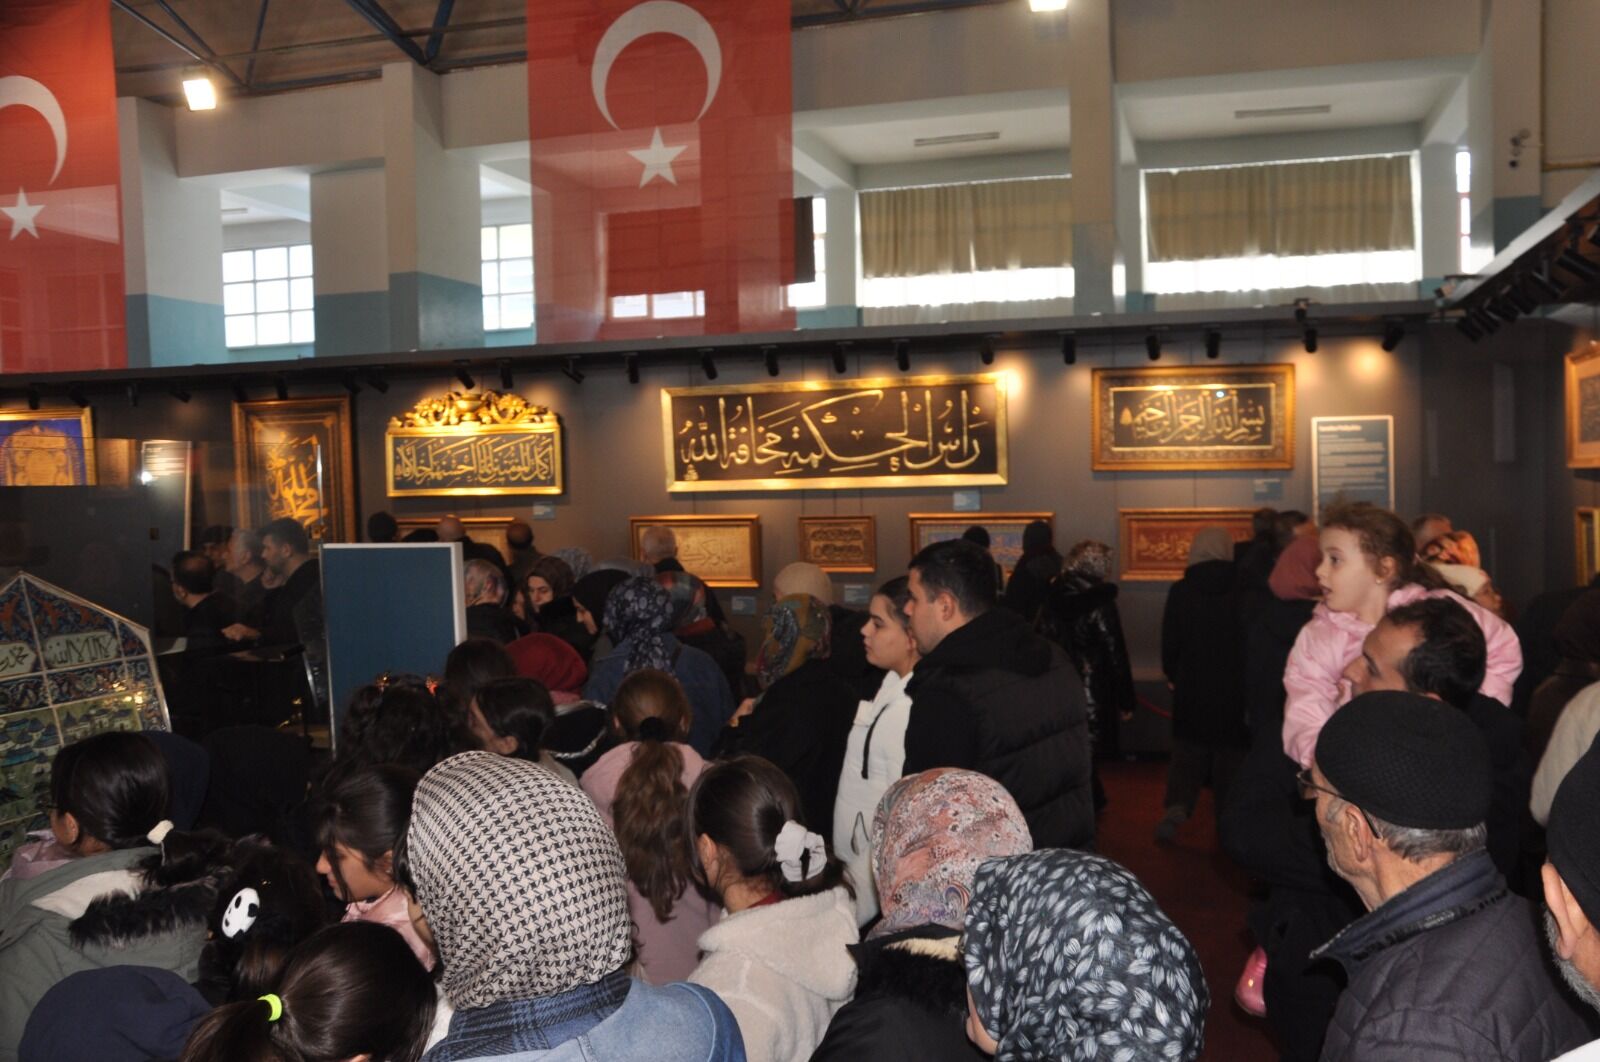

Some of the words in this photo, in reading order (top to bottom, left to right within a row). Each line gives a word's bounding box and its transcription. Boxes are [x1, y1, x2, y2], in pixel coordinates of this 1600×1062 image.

[680, 397, 728, 463] الله
[721, 396, 790, 468] مخافة
[781, 389, 933, 472] الحكمة
[1133, 391, 1178, 438] الرحيم
[1160, 391, 1212, 441] الرحمن
[1214, 391, 1238, 432] الله
[1224, 405, 1265, 440] بسم
